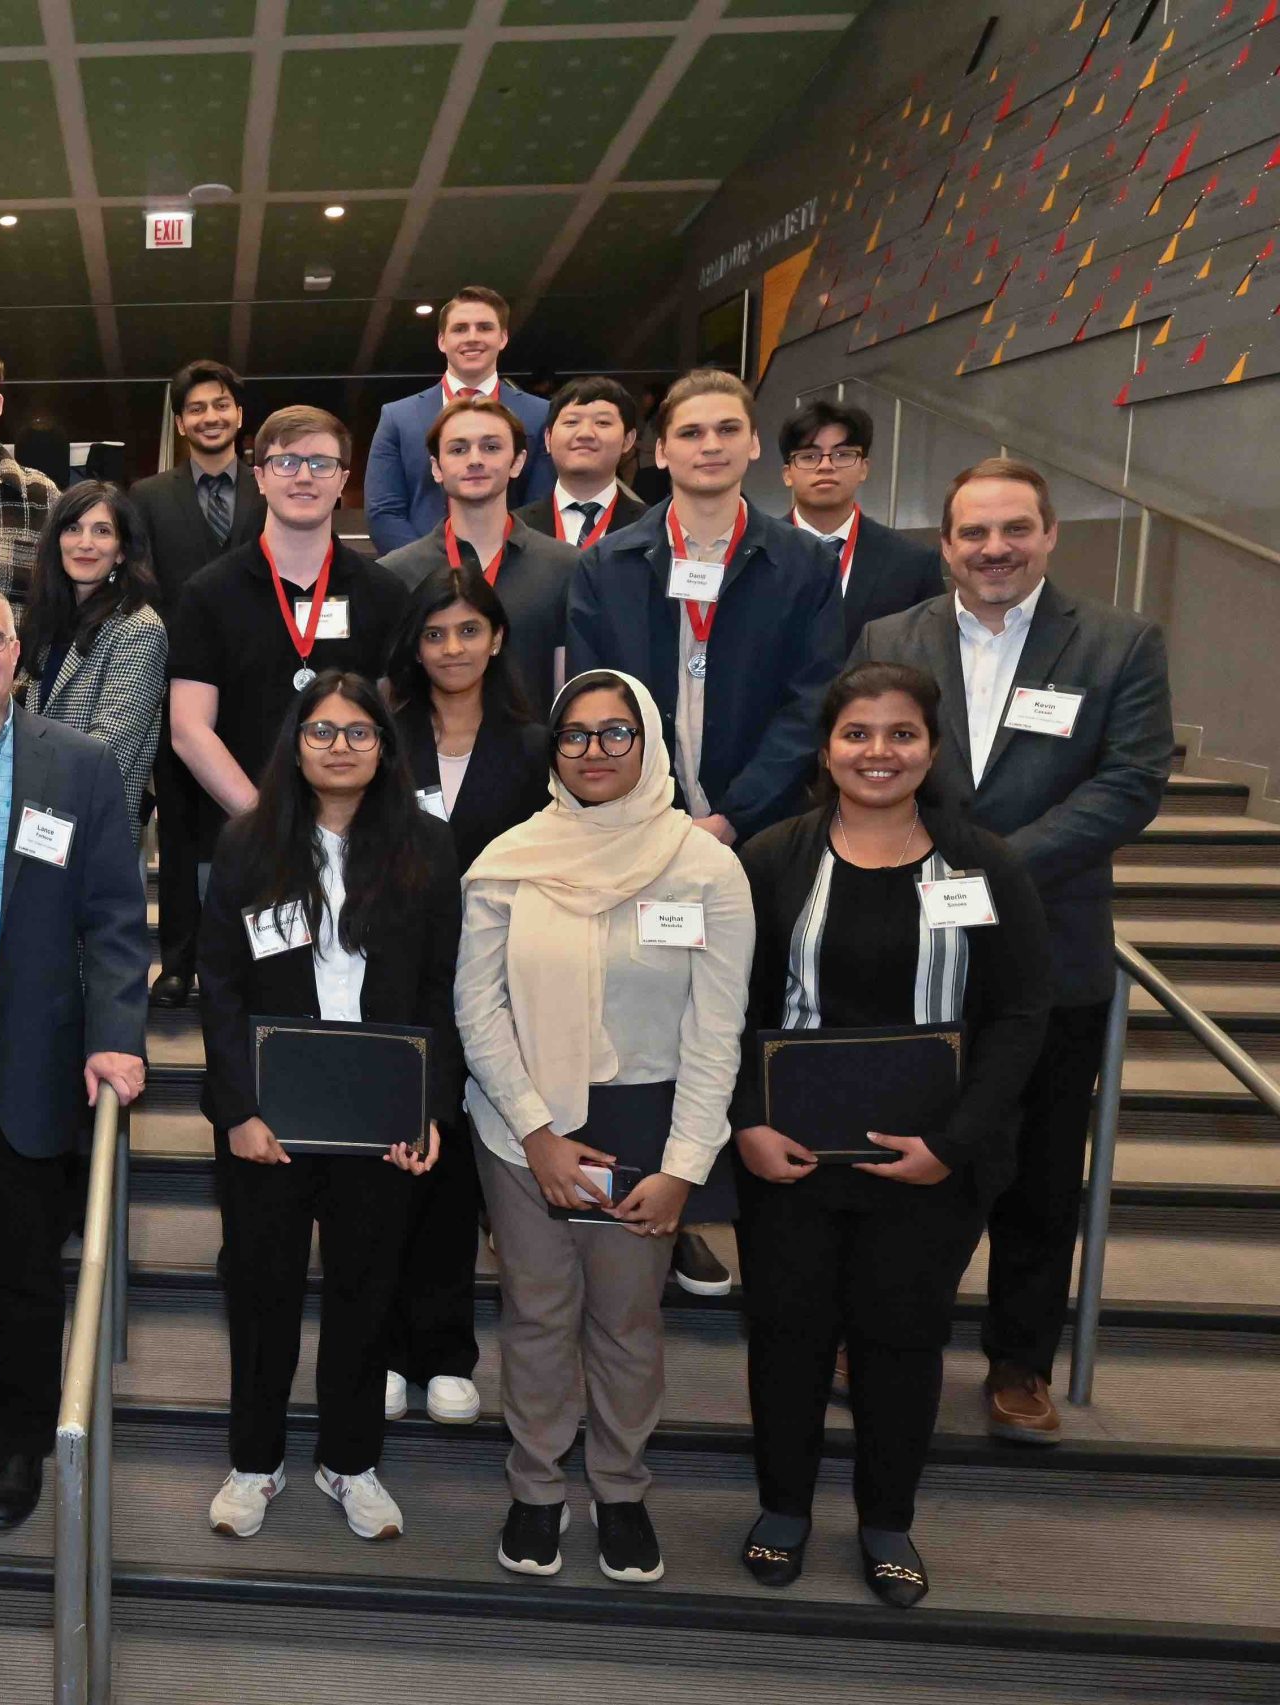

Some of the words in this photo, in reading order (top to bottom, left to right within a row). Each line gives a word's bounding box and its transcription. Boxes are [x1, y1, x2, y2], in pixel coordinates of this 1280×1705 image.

[154, 219, 184, 241] EXIT
[1034, 701, 1056, 710] Kevin
[37, 824, 55, 836] Lance
[943, 893, 967, 901] Merlin
[659, 915, 684, 923] Nujhat
